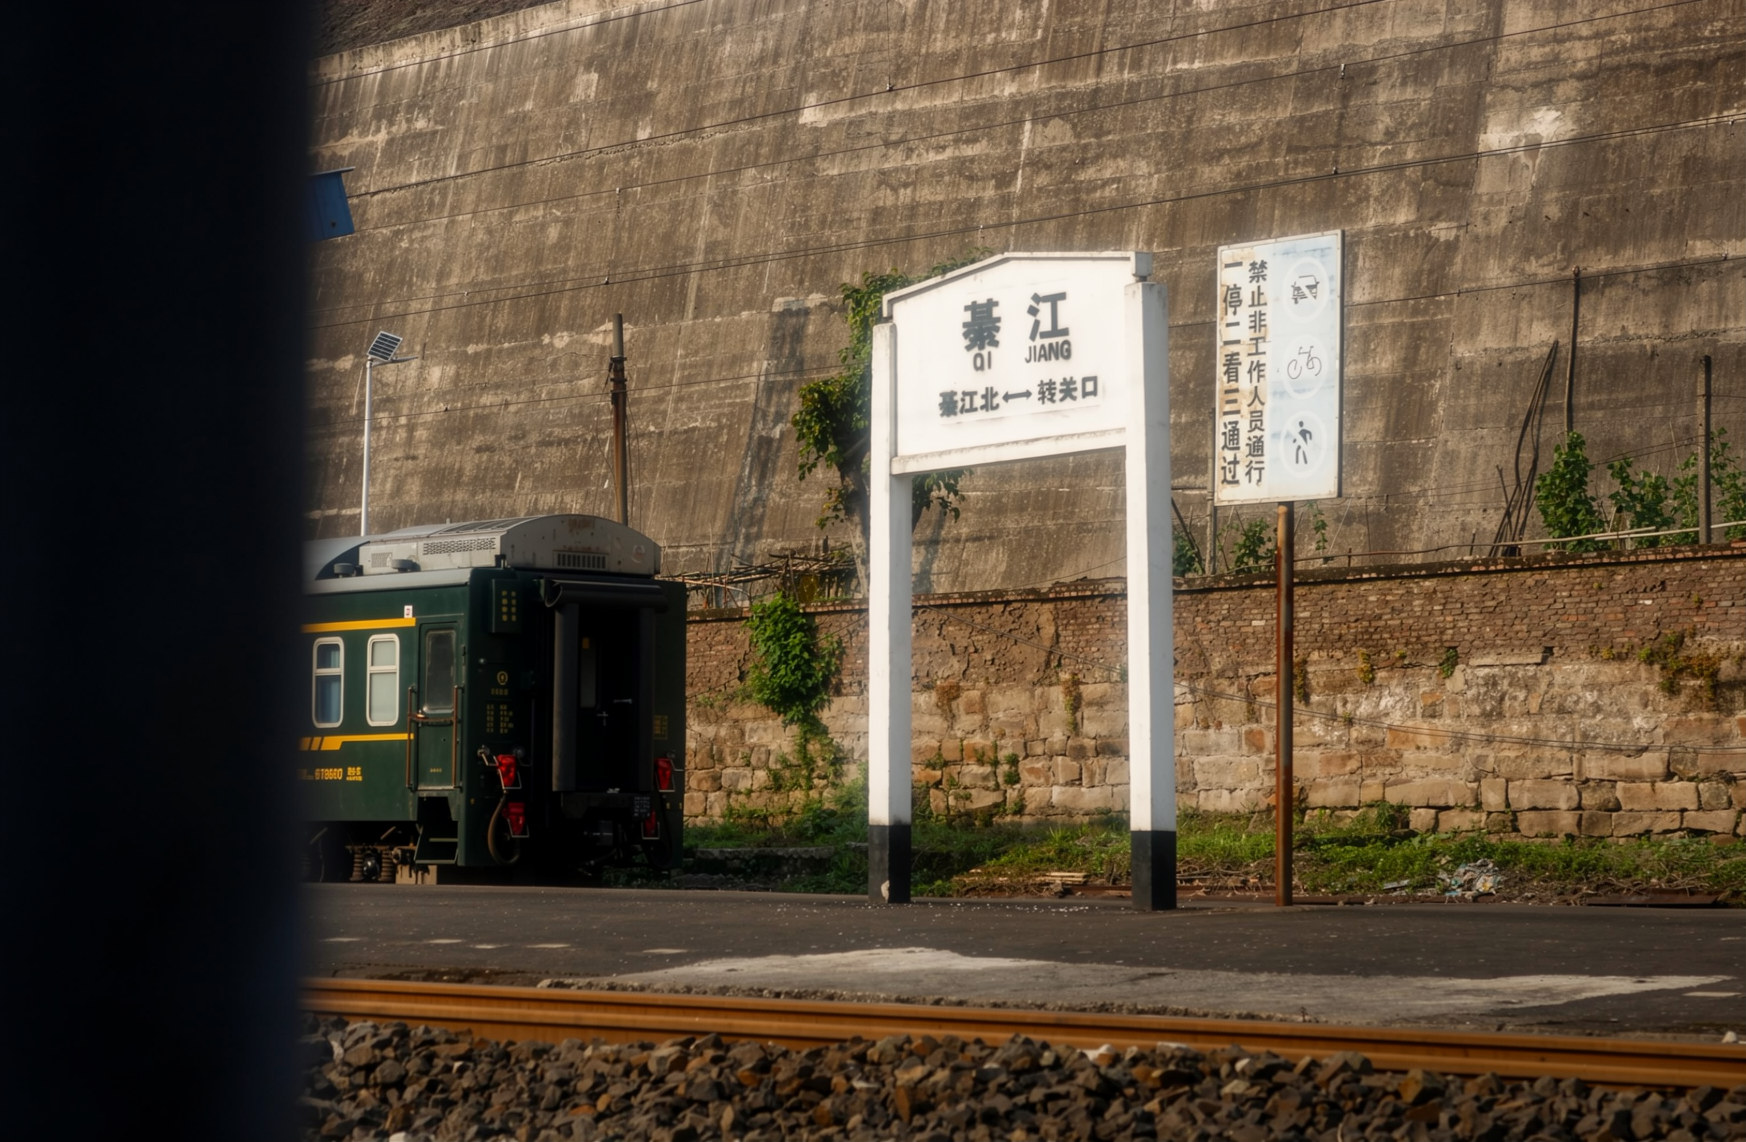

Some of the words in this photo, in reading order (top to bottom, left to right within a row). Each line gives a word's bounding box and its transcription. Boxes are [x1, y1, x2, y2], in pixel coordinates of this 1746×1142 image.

[973, 350, 992, 371] QI
[1025, 339, 1072, 364] JIANG
[1037, 375, 1098, 405] 转关口
[1221, 261, 1243, 486] 一停二看三通过
[1245, 260, 1268, 485] 禁止非工作人员通行
